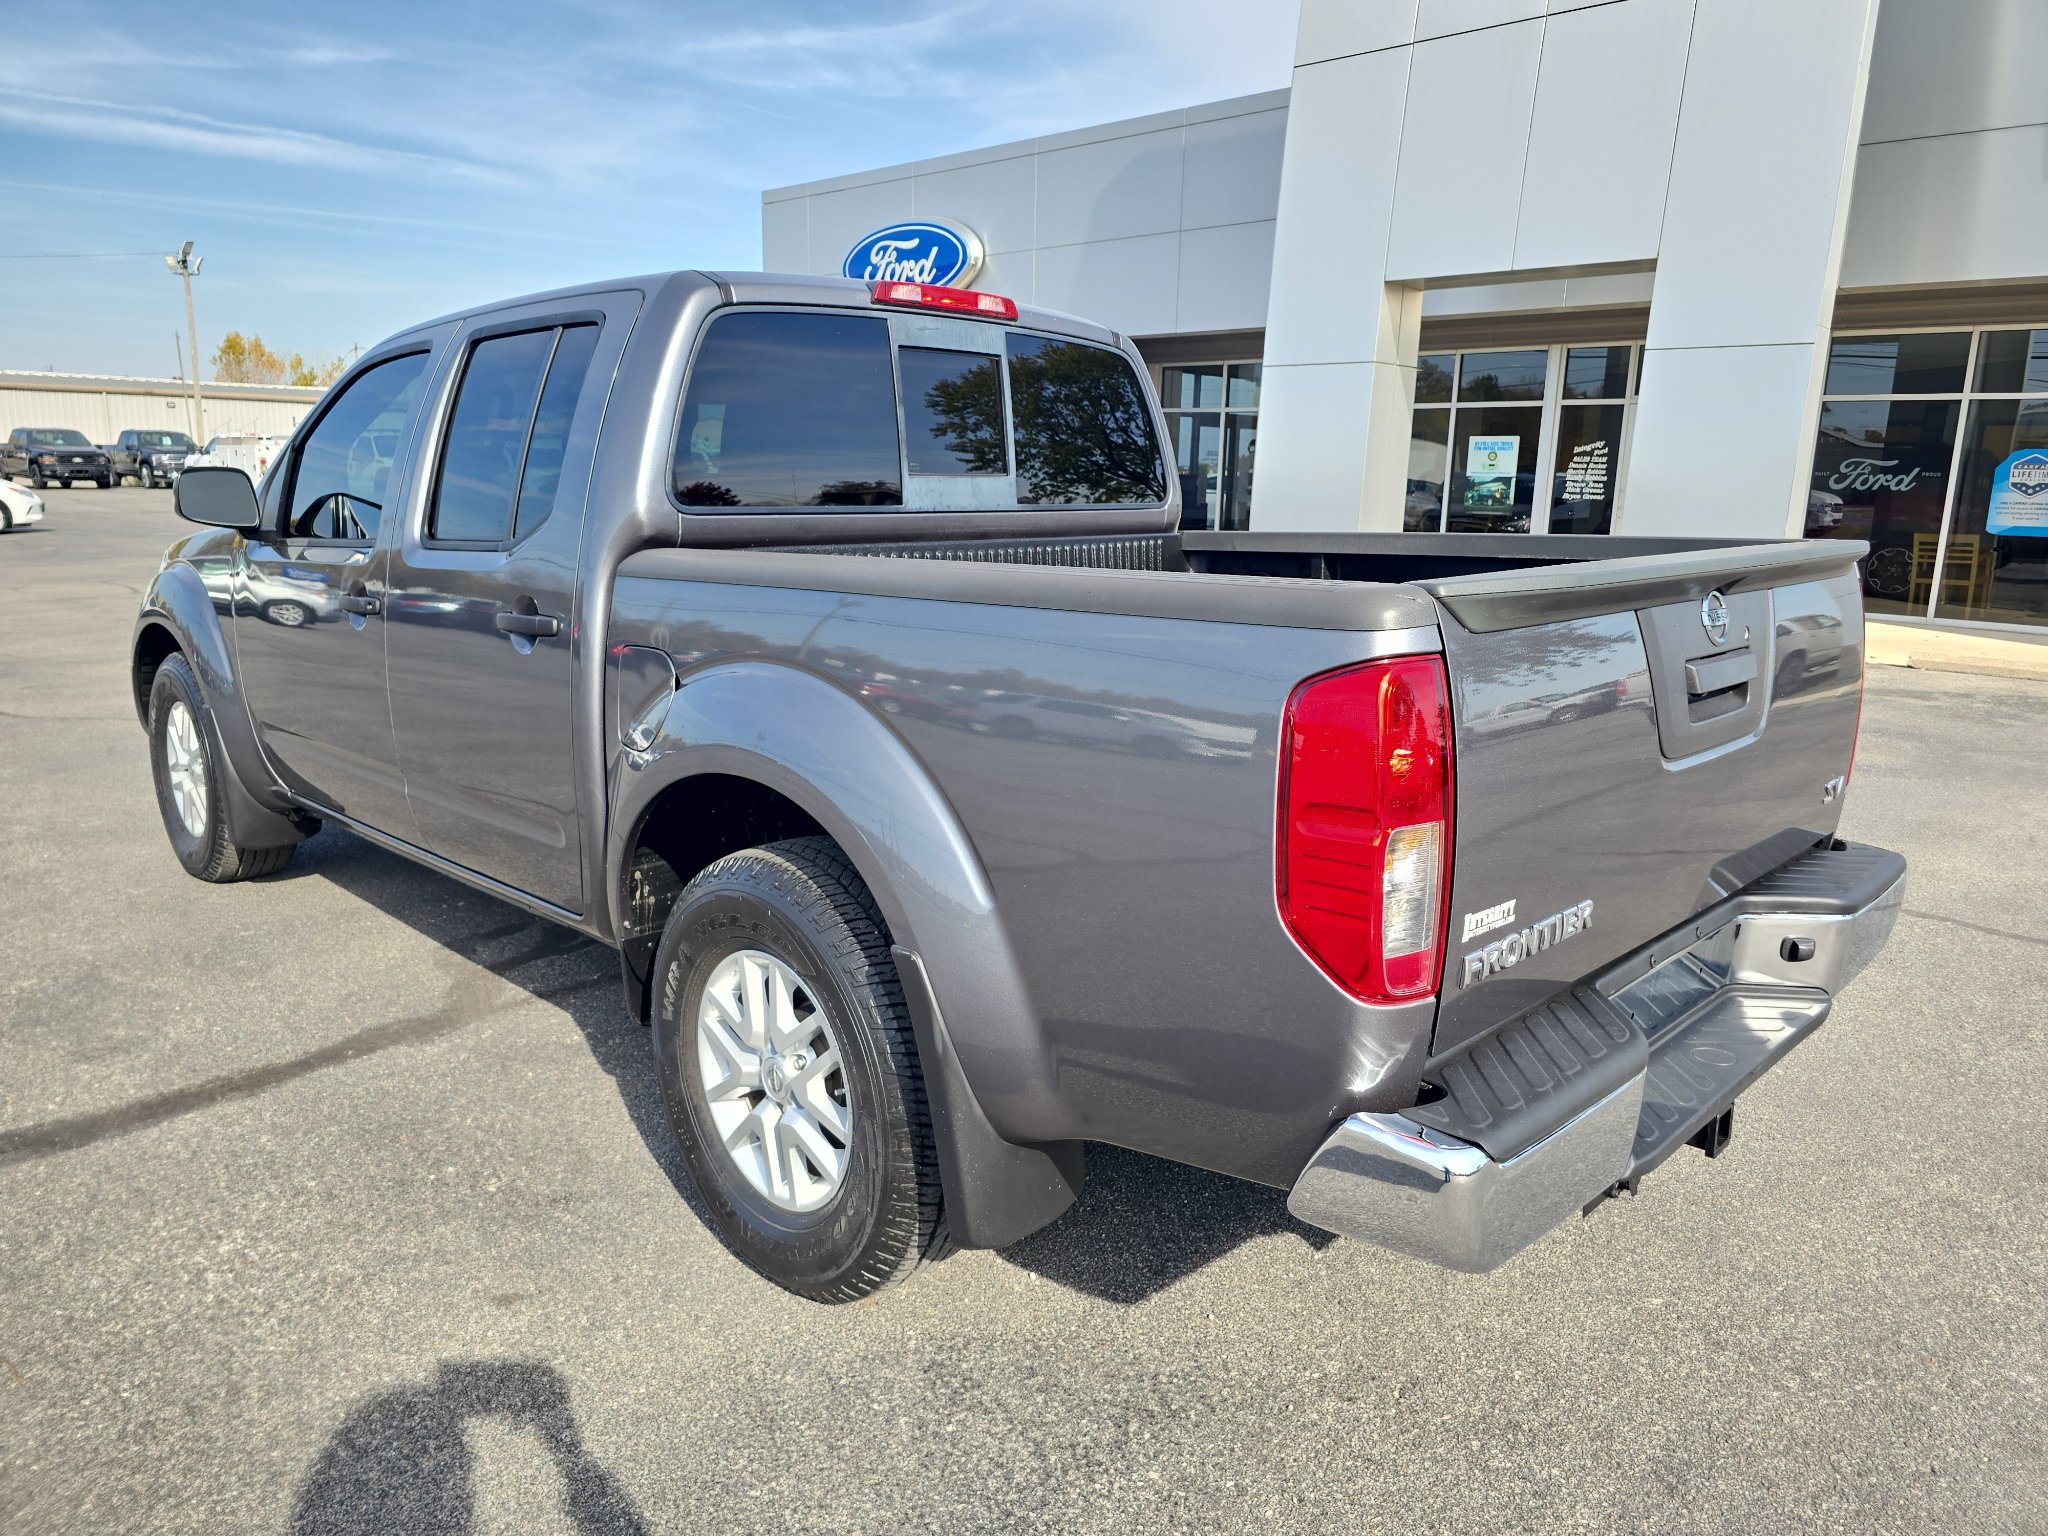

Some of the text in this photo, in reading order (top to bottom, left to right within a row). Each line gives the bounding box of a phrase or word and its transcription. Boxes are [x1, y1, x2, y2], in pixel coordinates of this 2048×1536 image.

[863, 237, 938, 283] Ford
[1573, 440, 1605, 453] Integrity
[1828, 457, 1921, 492] Ford
[2011, 470, 2048, 478] LIFETIM
[1822, 775, 1845, 805] SV
[1458, 899, 1594, 990] FRONTIER
